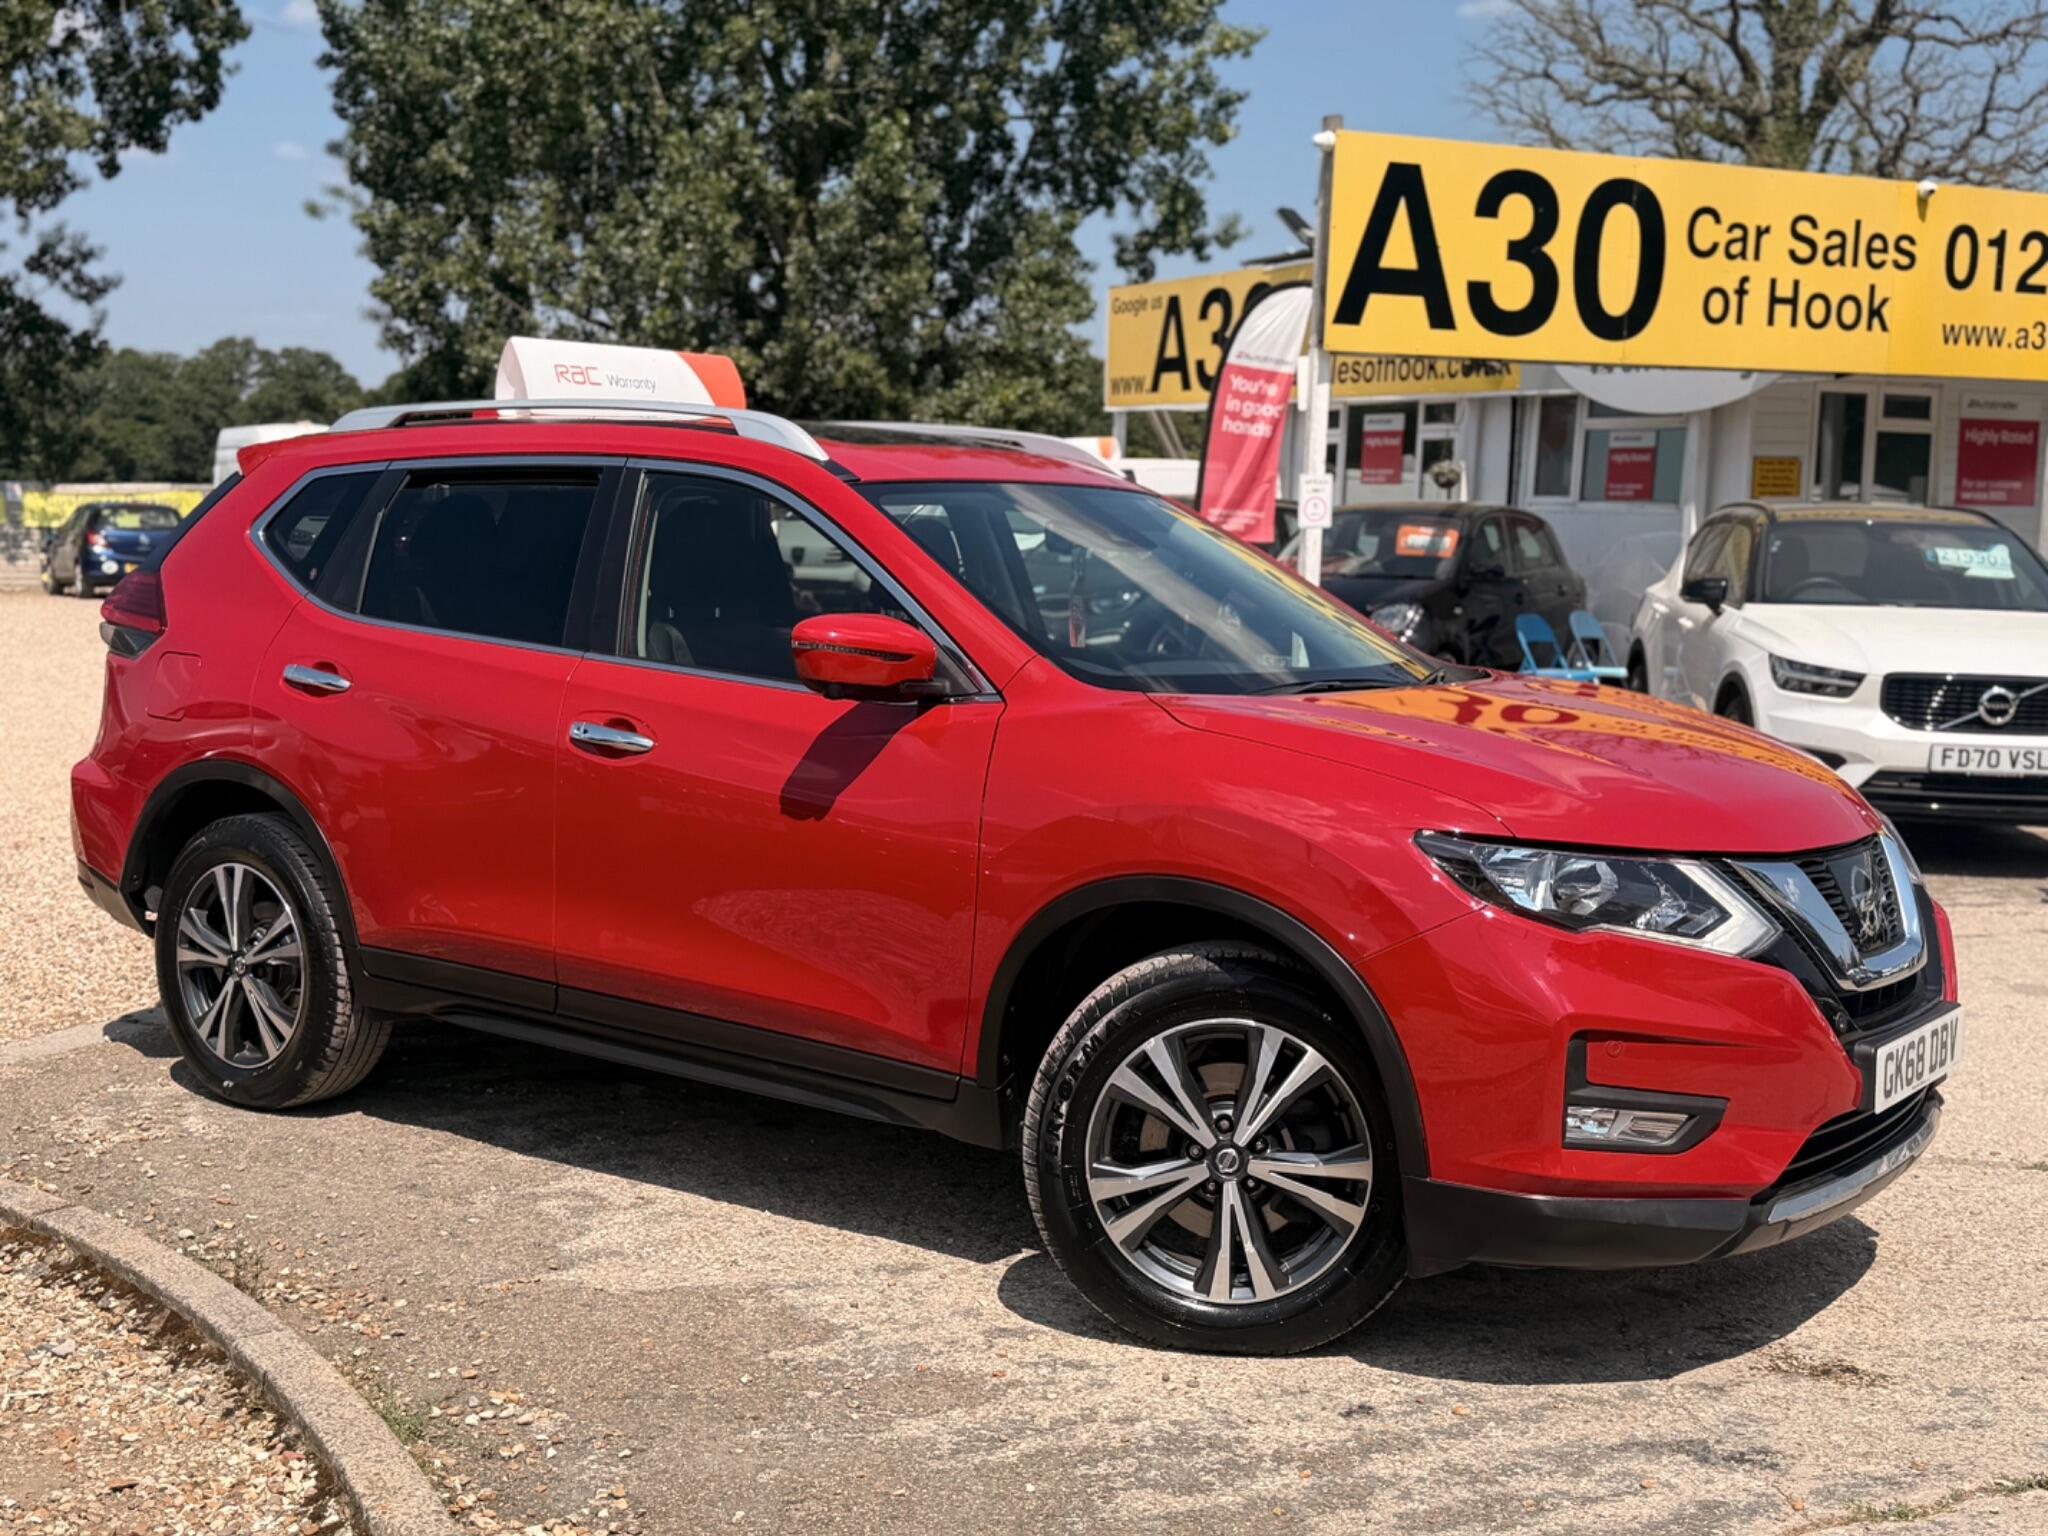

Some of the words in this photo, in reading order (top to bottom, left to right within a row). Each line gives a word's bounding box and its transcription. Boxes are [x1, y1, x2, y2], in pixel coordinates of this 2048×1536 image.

[1332, 161, 1666, 342] A30
[1687, 206, 1770, 261] Car
[1788, 214, 1917, 272] Sales
[1945, 223, 2048, 294] 012
[1112, 294, 1148, 316] Google
[1151, 295, 1162, 309] us
[1703, 276, 1749, 326] of
[1767, 277, 1890, 333] Hook
[1942, 321, 2048, 351] www.a3
[606, 374, 657, 394] Warranty
[1230, 374, 1279, 398] You're
[1225, 394, 1241, 413] in
[1222, 415, 1274, 439] hands
[1941, 748, 2001, 769] FD70
[2008, 750, 2048, 771] VSL
[1883, 1034, 1926, 1099] GK68
[1929, 1016, 1959, 1075] DBV
